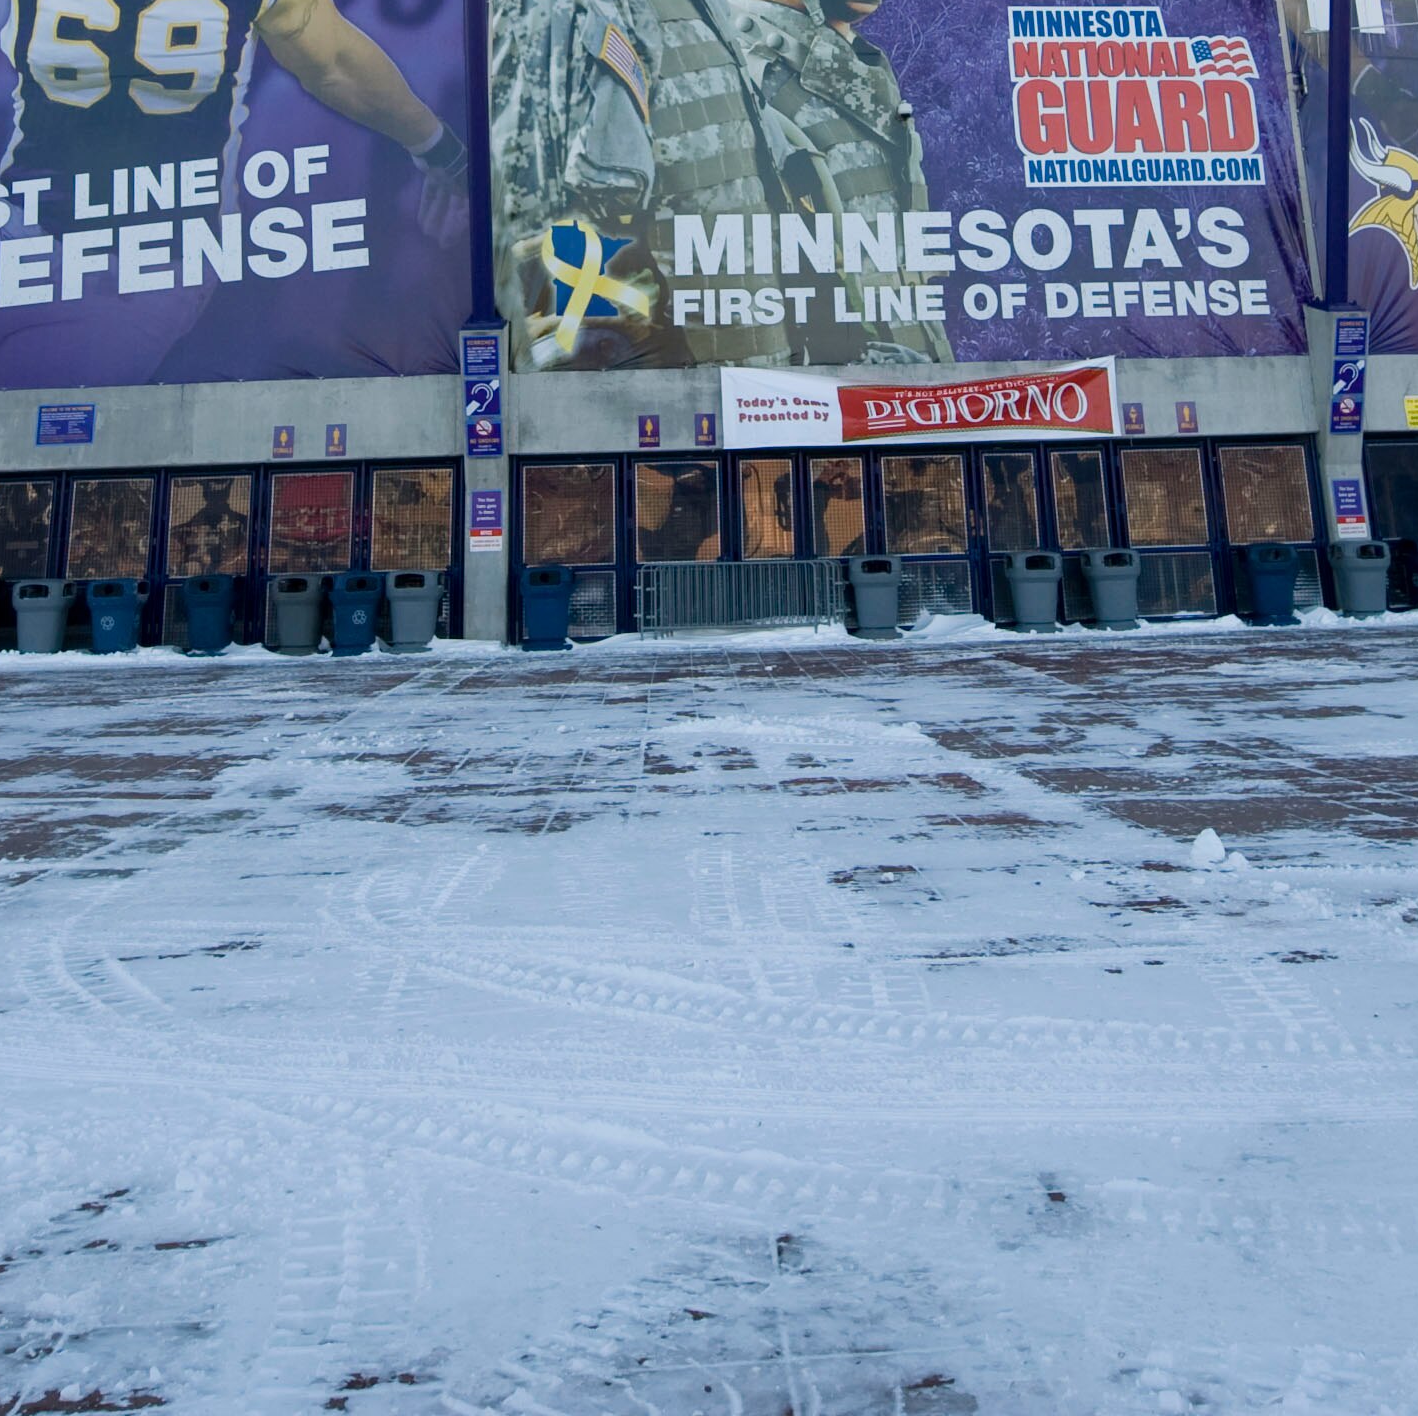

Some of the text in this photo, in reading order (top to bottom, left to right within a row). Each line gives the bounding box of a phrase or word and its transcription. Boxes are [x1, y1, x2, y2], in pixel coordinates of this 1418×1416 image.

[1012, 10, 1163, 37] MINNESOTA
[1013, 41, 1196, 78] NATIONAL
[1017, 79, 1256, 155] GUARD
[74, 158, 219, 220] LINE
[243, 144, 329, 199] OF
[1028, 158, 1261, 183] NATIONALGUARD.COM
[674, 207, 1250, 276] MINNESOTA'S
[673, 279, 1270, 326] FIRST LINE OF DEFENSE
[736, 396, 788, 409] Today's
[739, 410, 829, 423] Presented by
